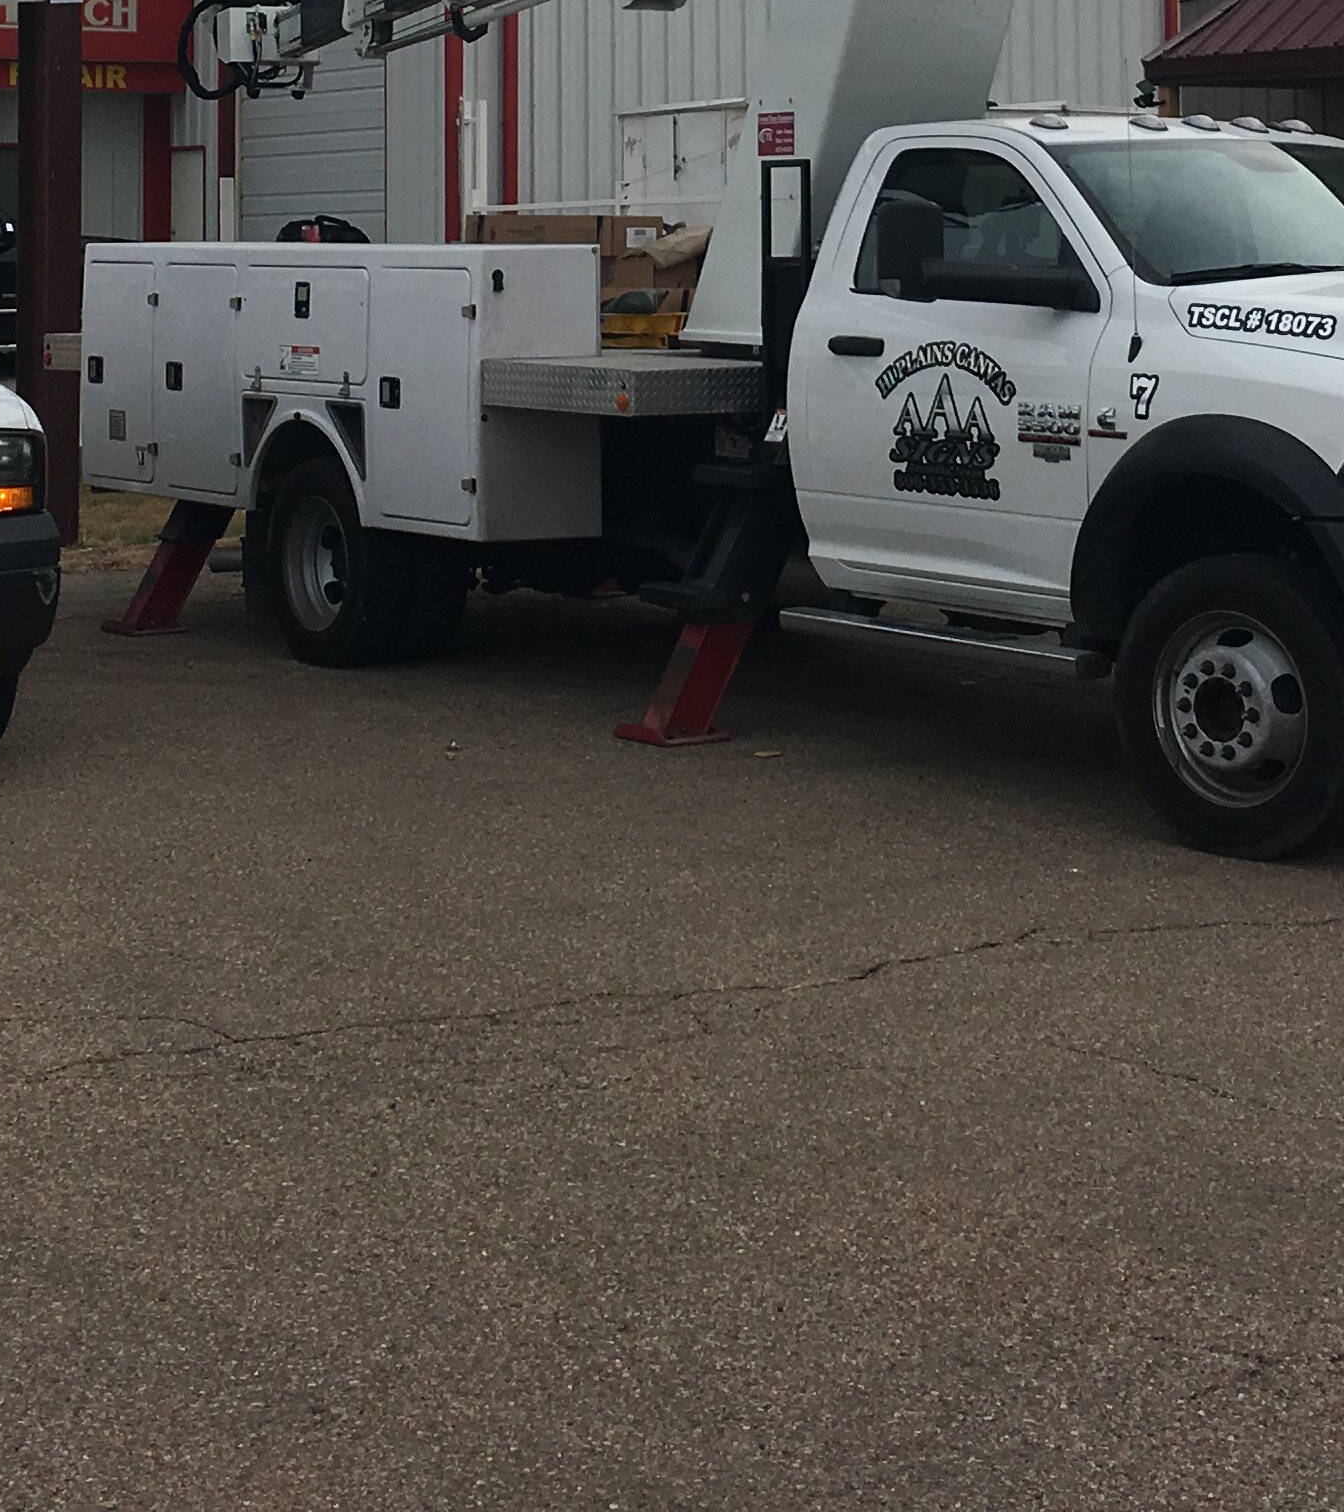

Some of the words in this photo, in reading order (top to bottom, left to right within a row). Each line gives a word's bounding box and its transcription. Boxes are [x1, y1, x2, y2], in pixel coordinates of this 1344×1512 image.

[1189, 304, 1241, 329] TSCL
[1246, 309, 1263, 331] #
[1266, 310, 1336, 339] 18073
[894, 341, 956, 377] PLAINS
[955, 343, 1017, 406] CANVAS
[1130, 373, 1159, 420] 7
[893, 373, 995, 443] AAA
[889, 435, 1001, 470] SIGNS
